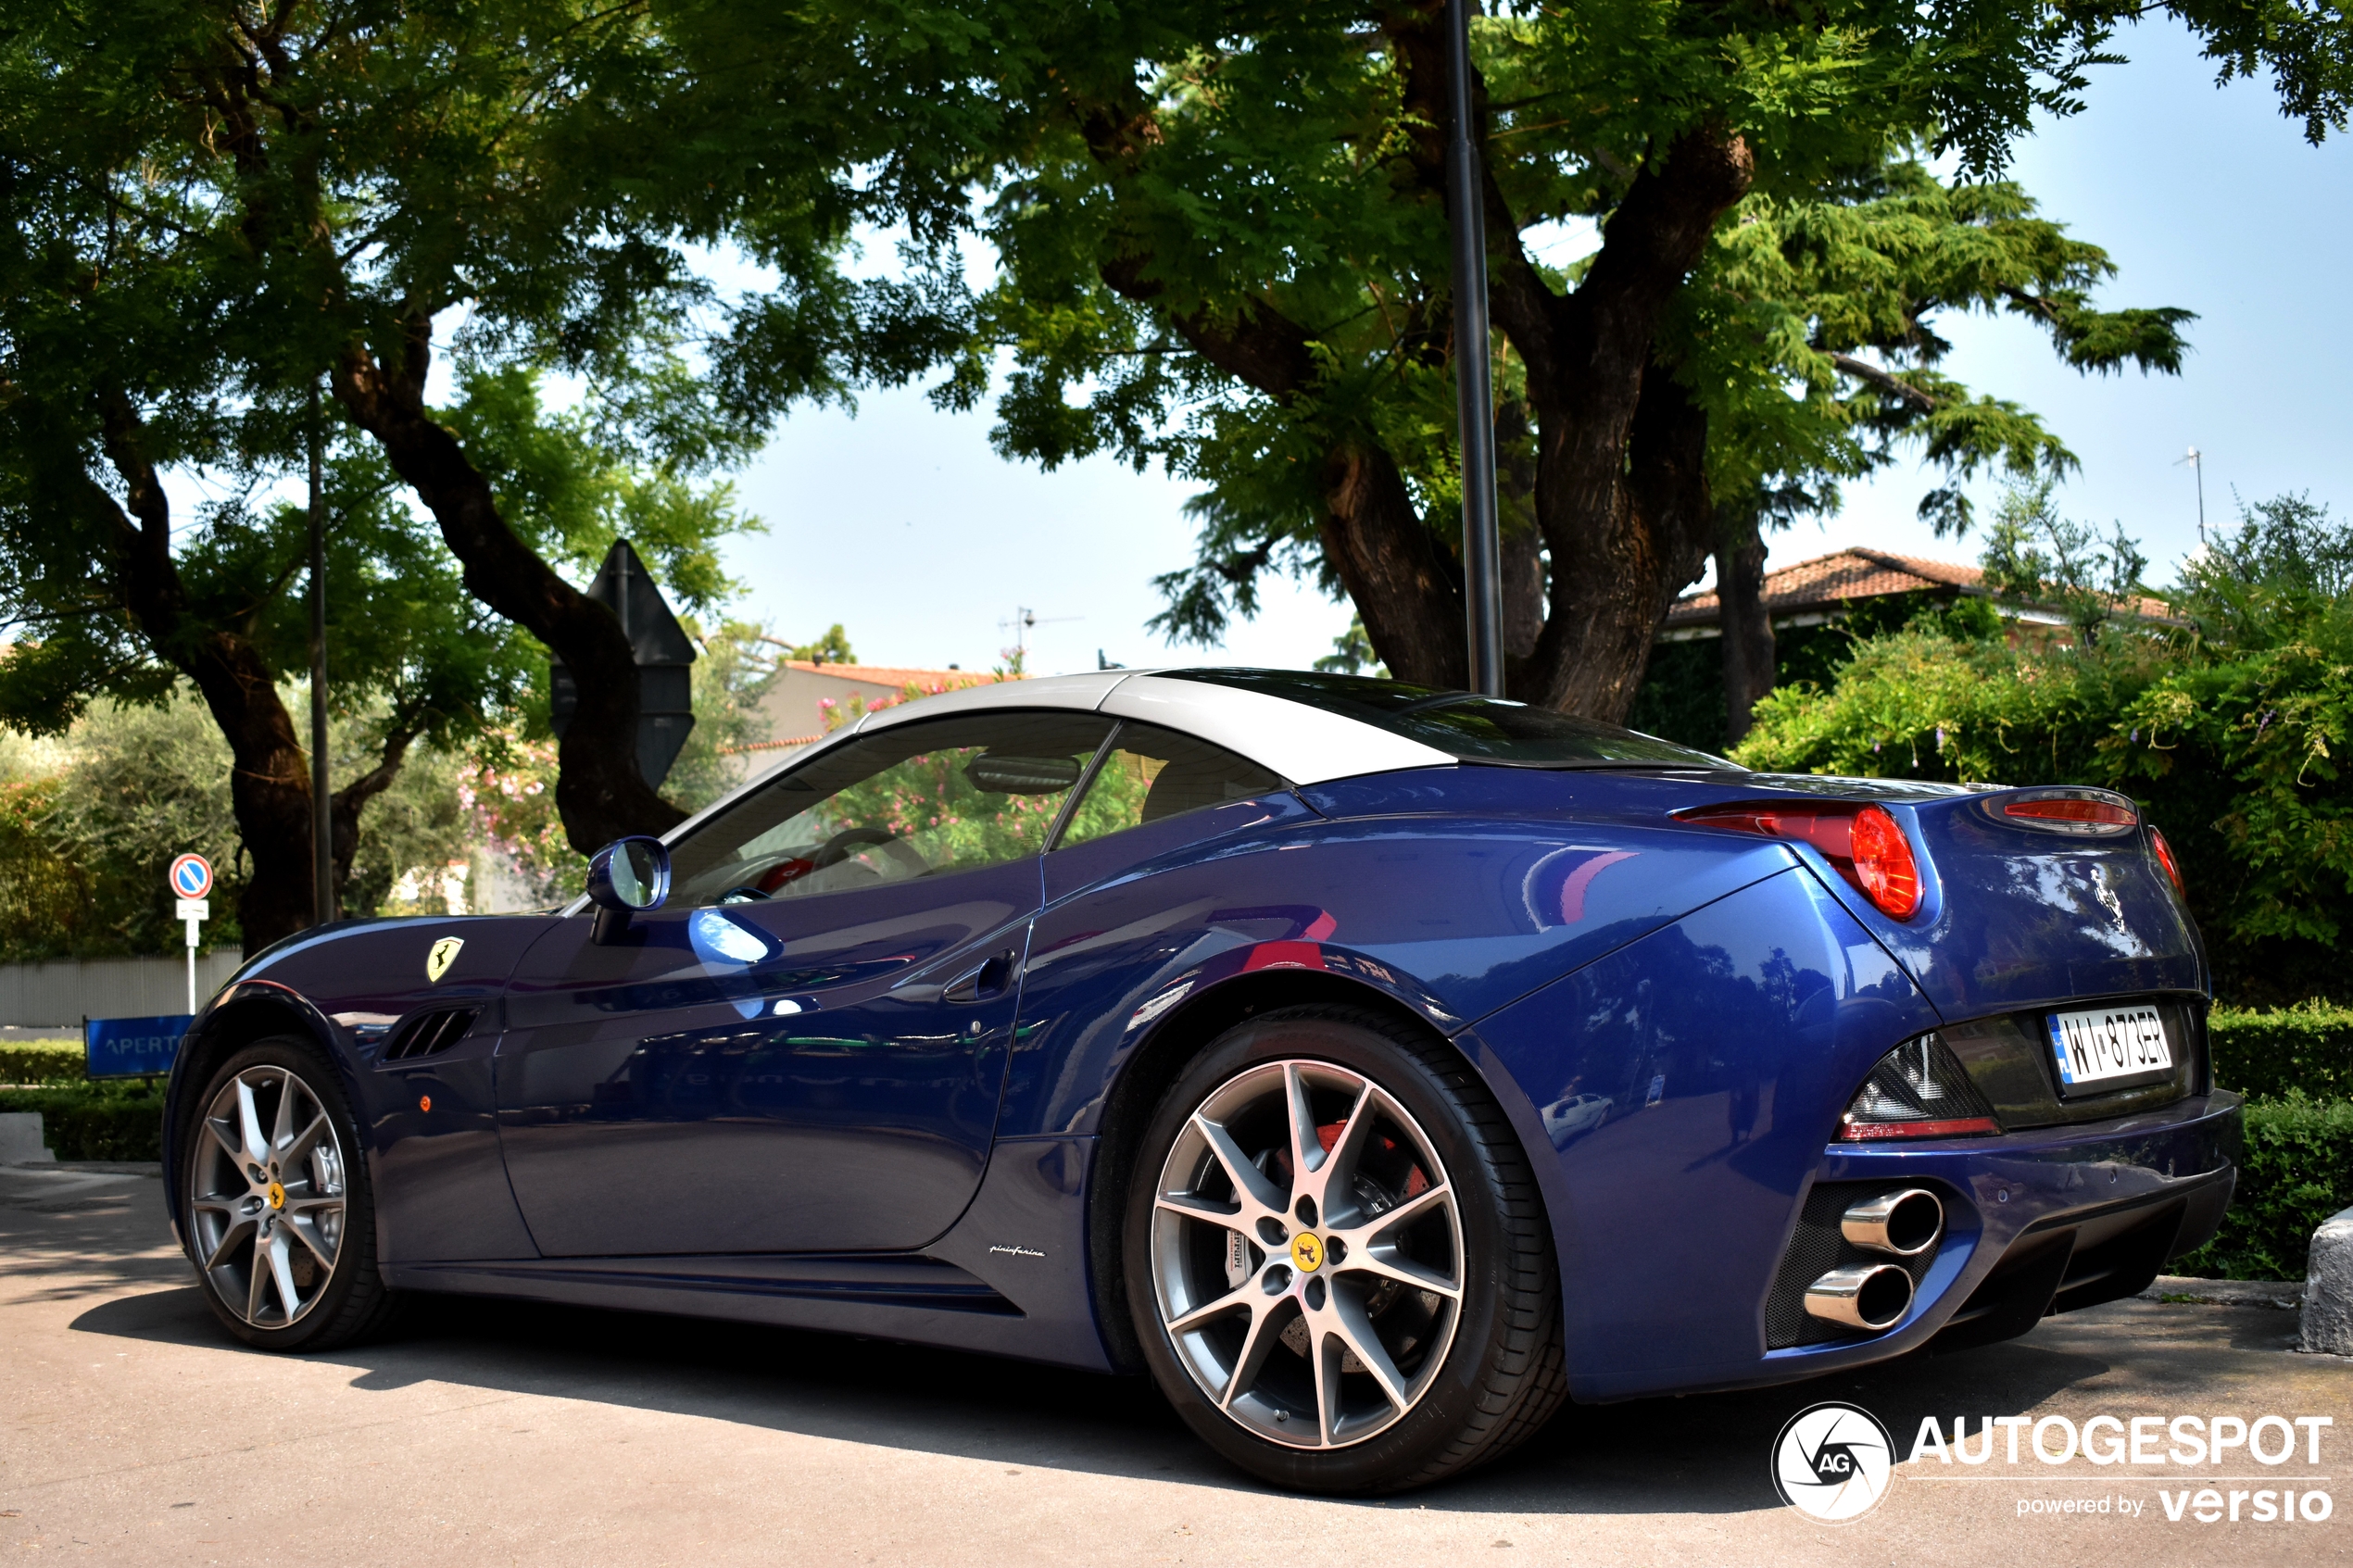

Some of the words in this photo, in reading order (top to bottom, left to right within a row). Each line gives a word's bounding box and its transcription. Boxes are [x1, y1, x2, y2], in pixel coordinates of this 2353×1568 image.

[2064, 1017, 2102, 1075] WI
[2105, 1011, 2168, 1068] 873ER
[989, 1245, 1046, 1257] pininfarina
